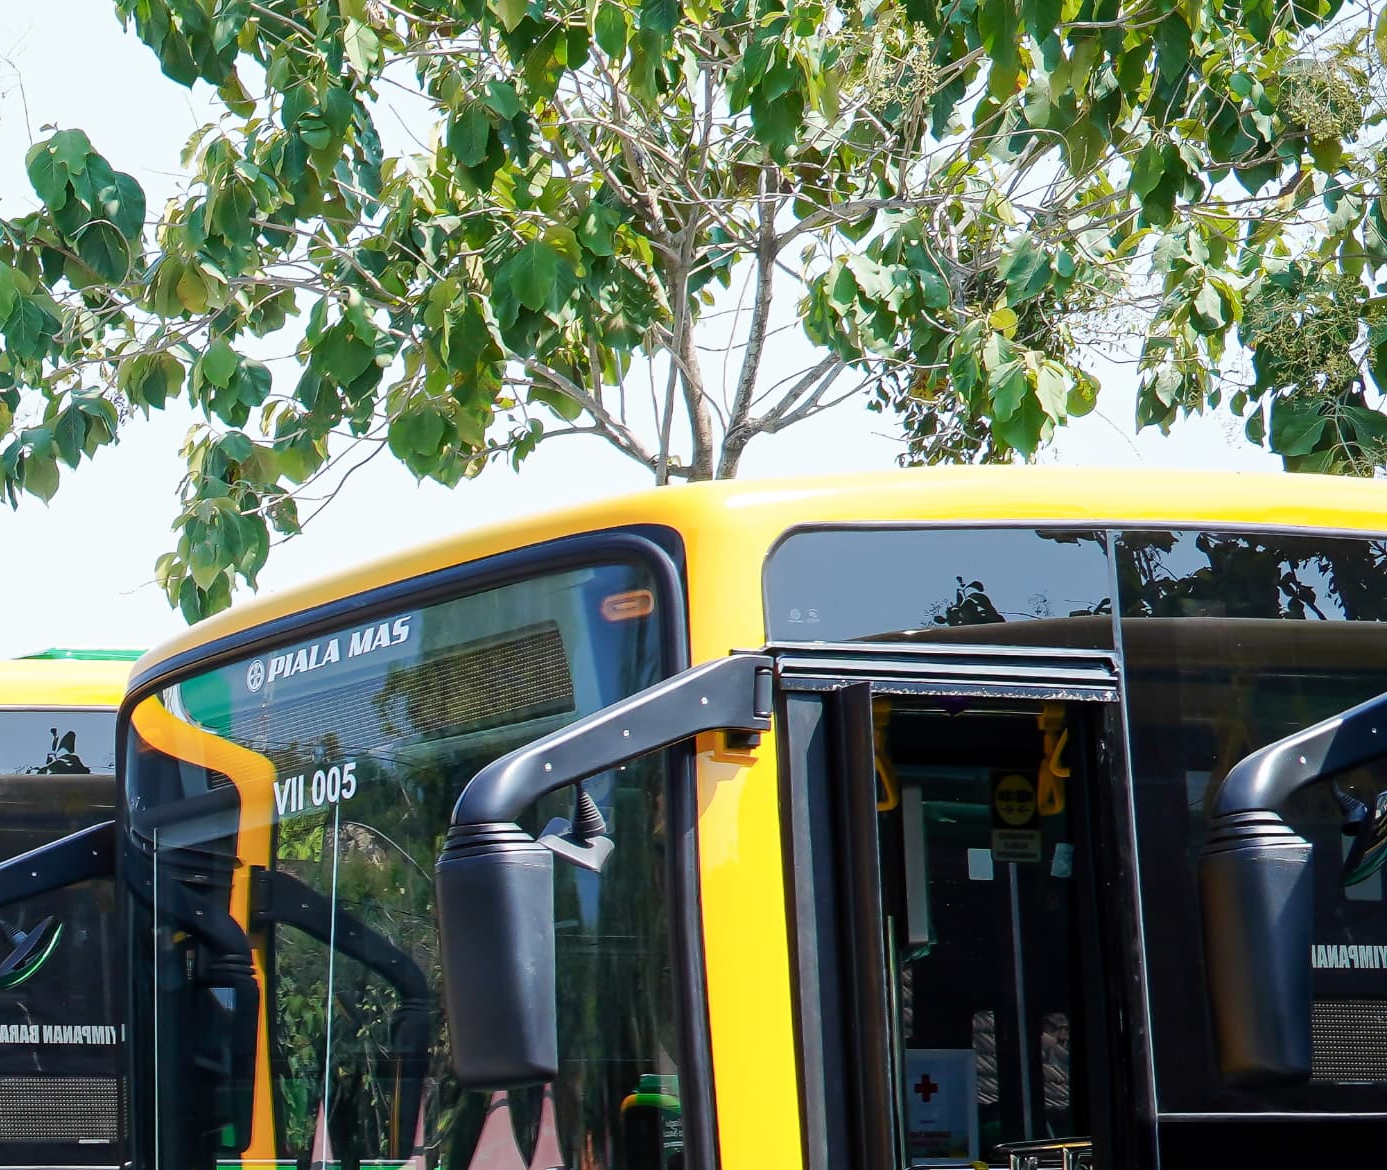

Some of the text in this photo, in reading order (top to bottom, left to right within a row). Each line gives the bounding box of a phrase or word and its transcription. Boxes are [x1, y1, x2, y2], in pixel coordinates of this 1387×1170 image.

[267, 616, 411, 683] PIALA MAS
[273, 762, 357, 815] VII 005
